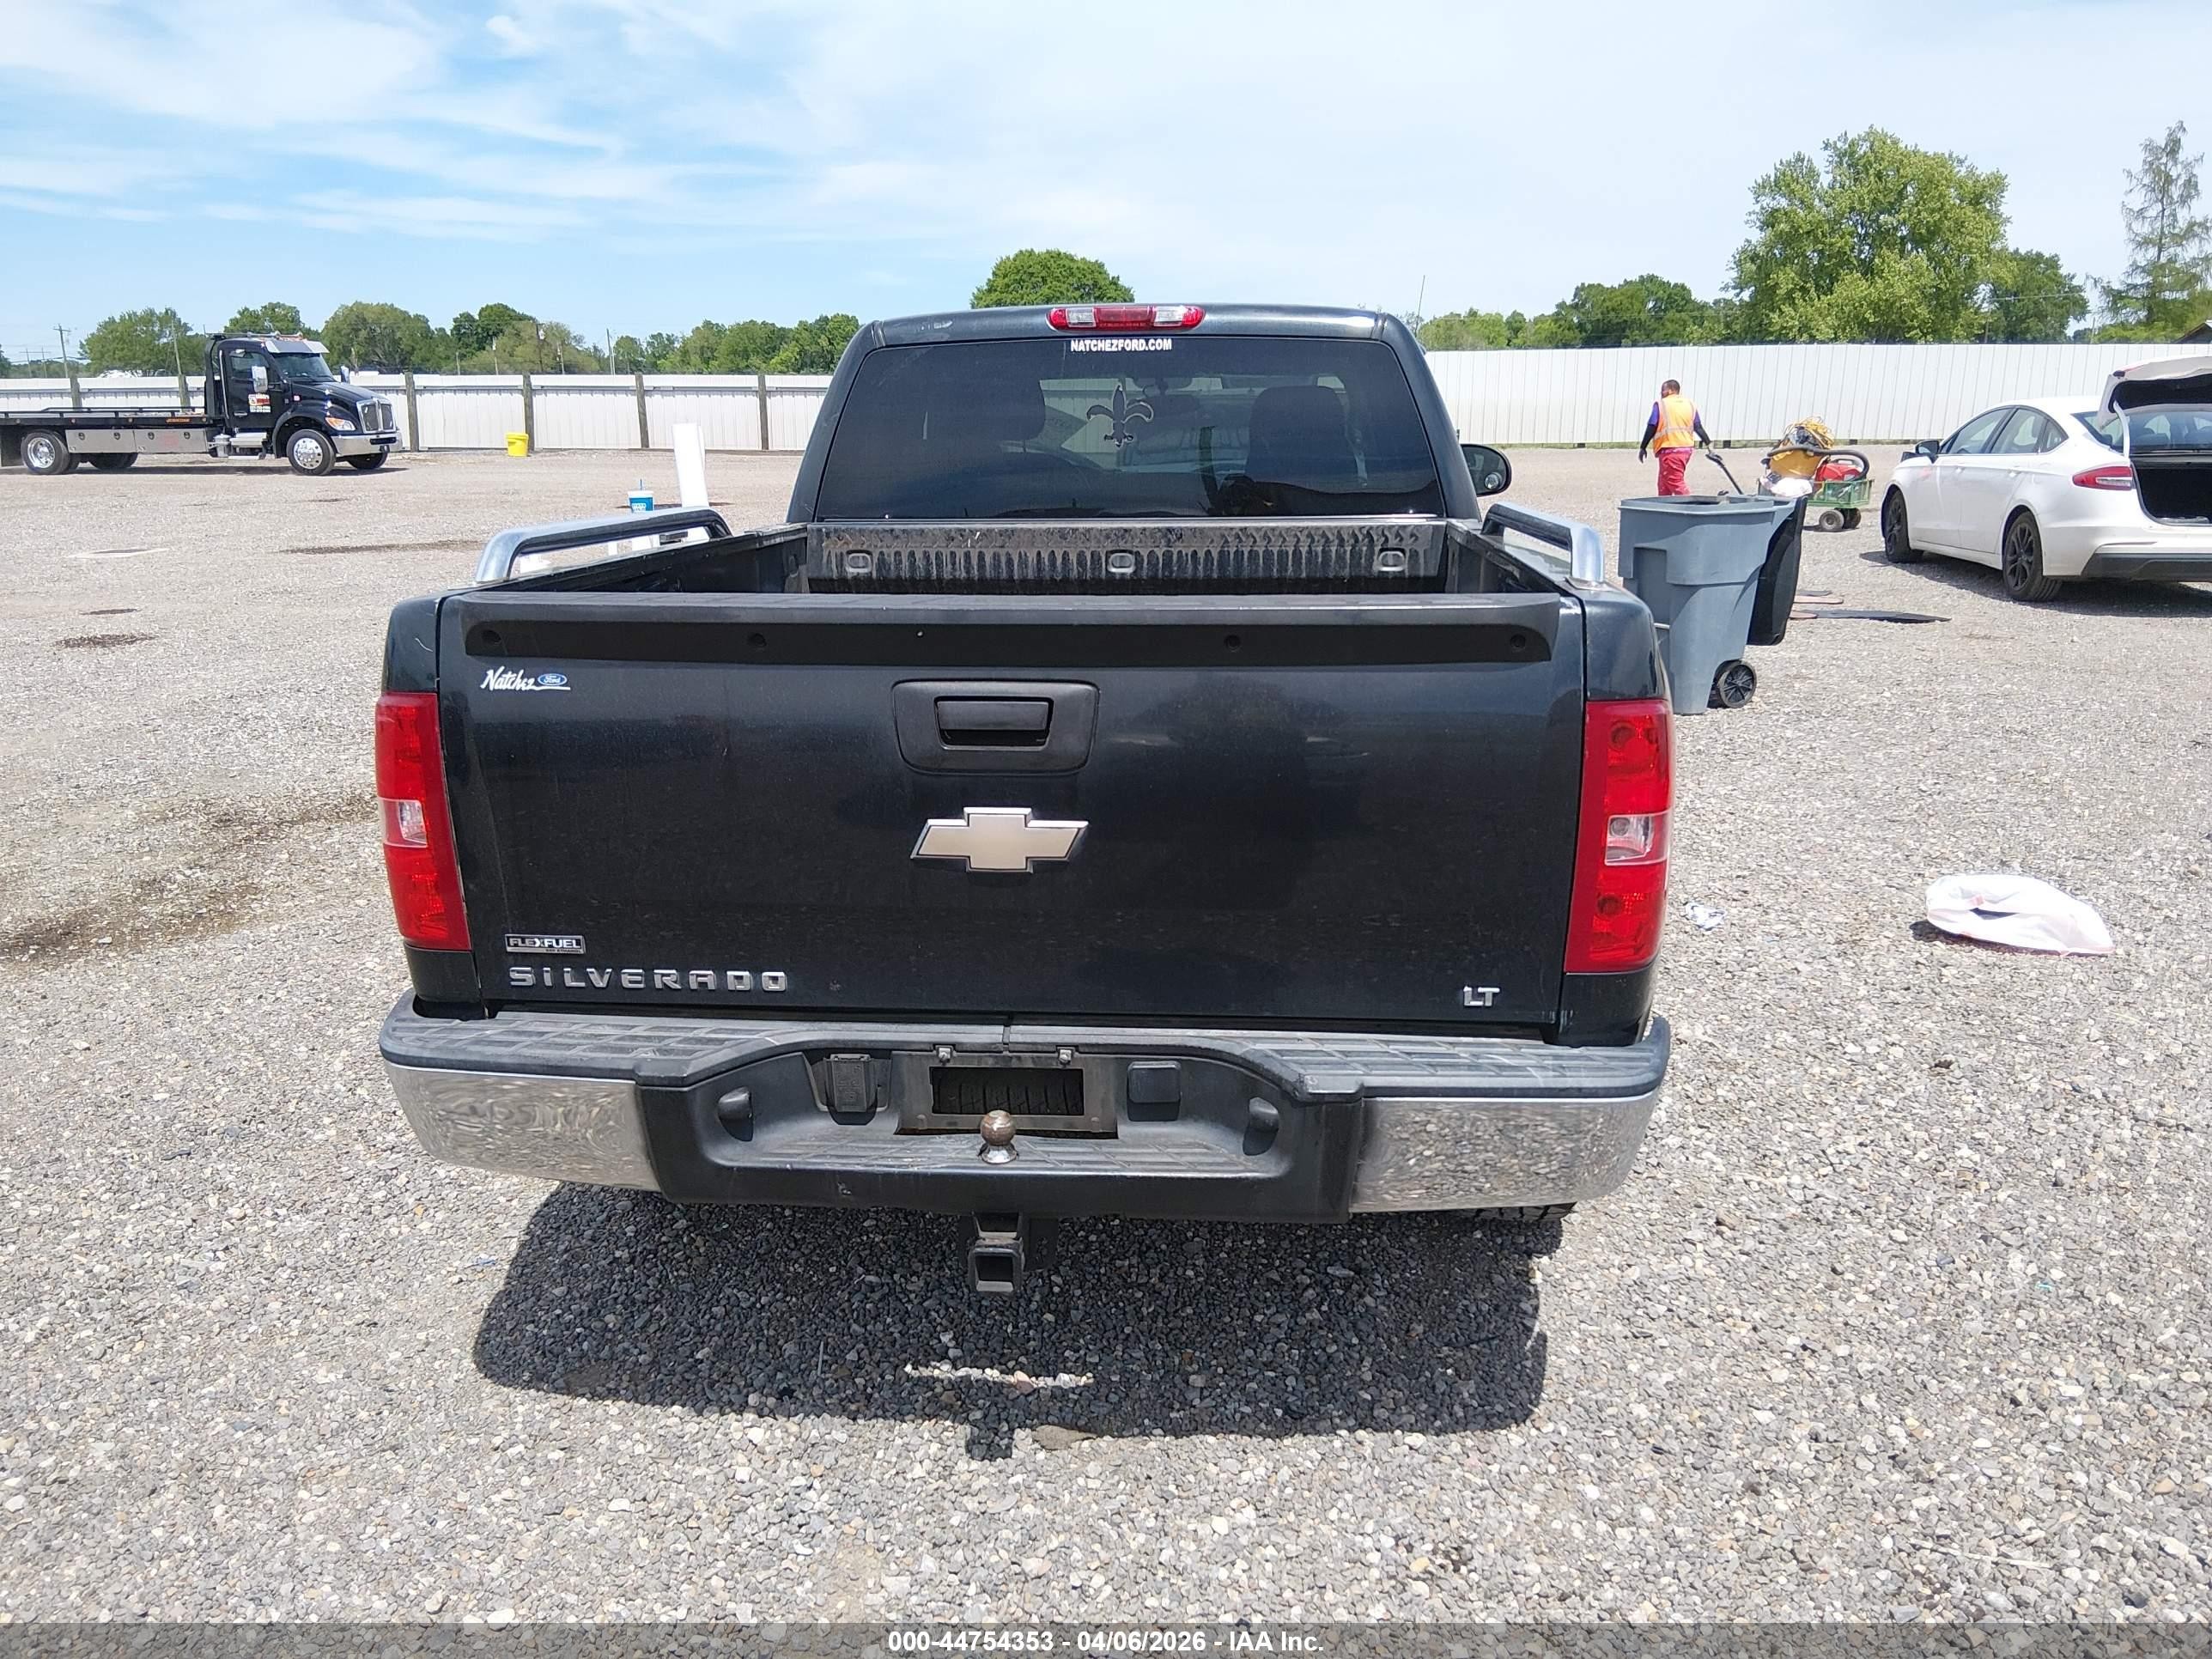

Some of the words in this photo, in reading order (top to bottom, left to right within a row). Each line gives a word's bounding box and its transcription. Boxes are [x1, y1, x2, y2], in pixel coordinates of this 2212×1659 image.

[1070, 338, 1172, 351] NATCHEZFORD.COM
[508, 938, 581, 949] FLEXFUEL
[508, 966, 788, 992] SILVERADO
[1463, 986, 1500, 1006] LT
